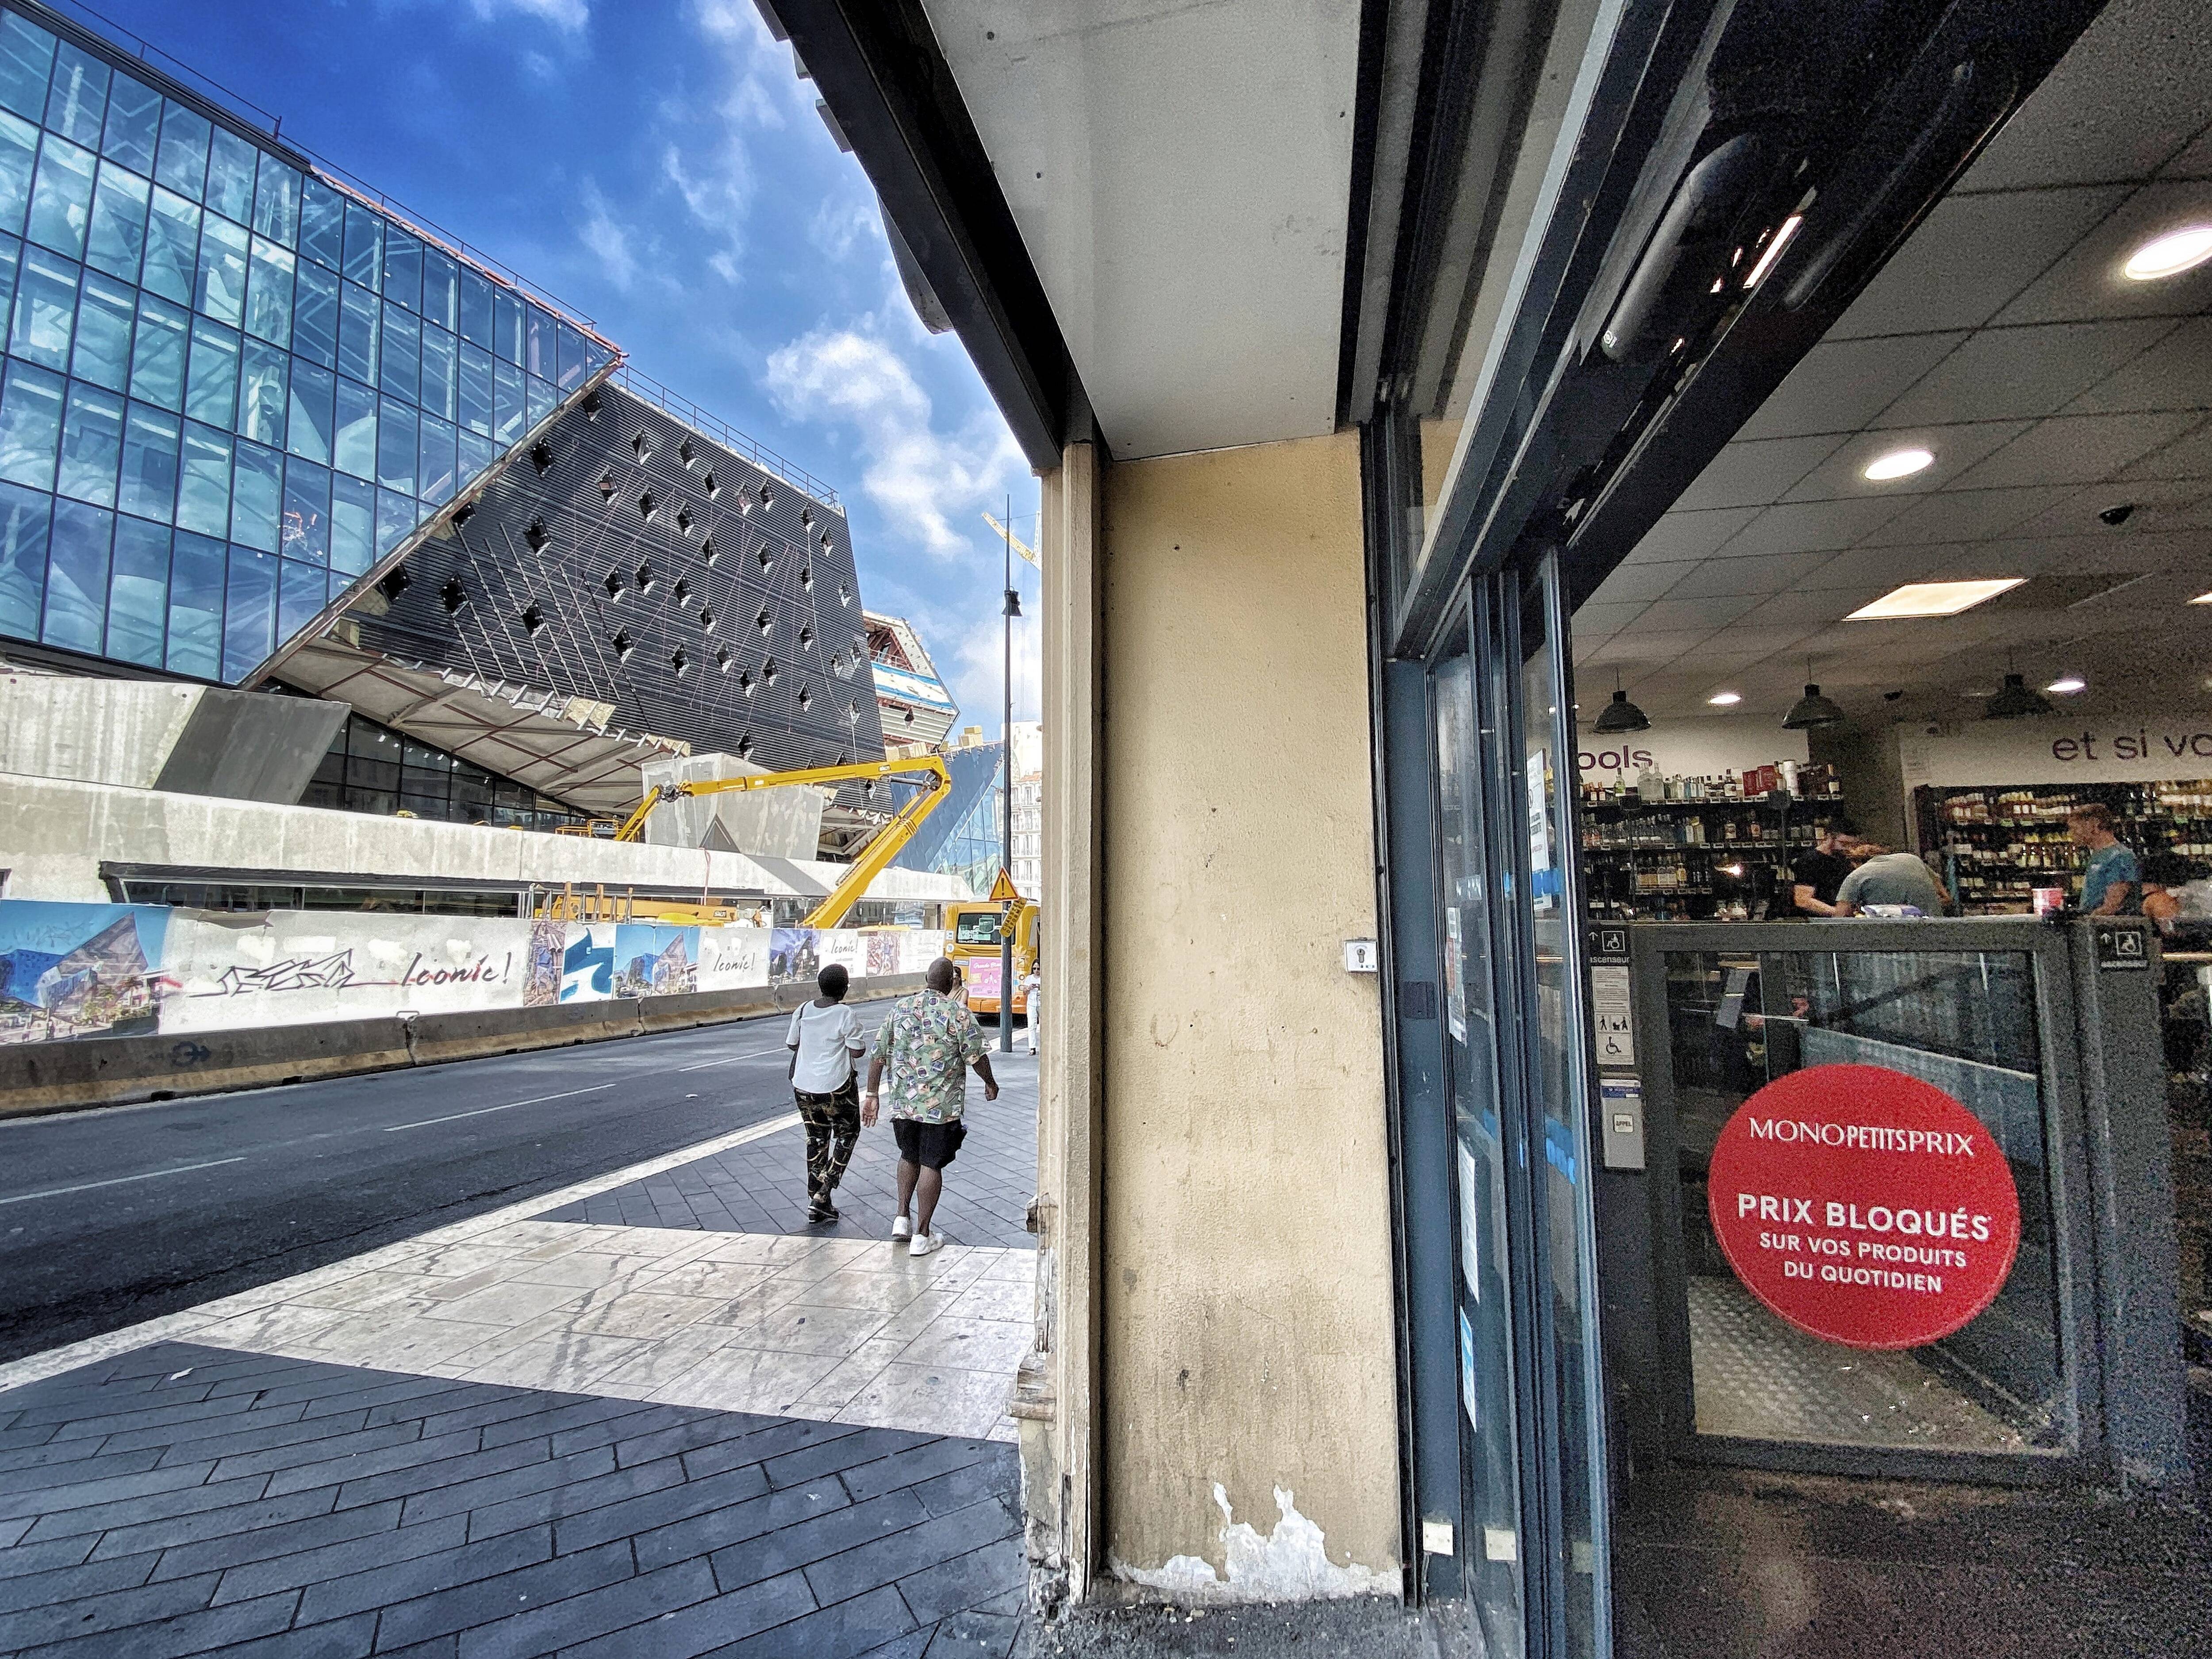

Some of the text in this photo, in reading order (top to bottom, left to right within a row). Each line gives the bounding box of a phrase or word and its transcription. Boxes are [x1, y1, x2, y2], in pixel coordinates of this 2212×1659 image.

[2053, 731, 2098, 760] et
[2114, 728, 2147, 760] si
[1738, 1192, 1813, 1225] PRIX
[1759, 1232, 1967, 1267] SUR VOS PRODUITS
[1784, 1260, 1943, 1293] DU QUOTIDIEN
